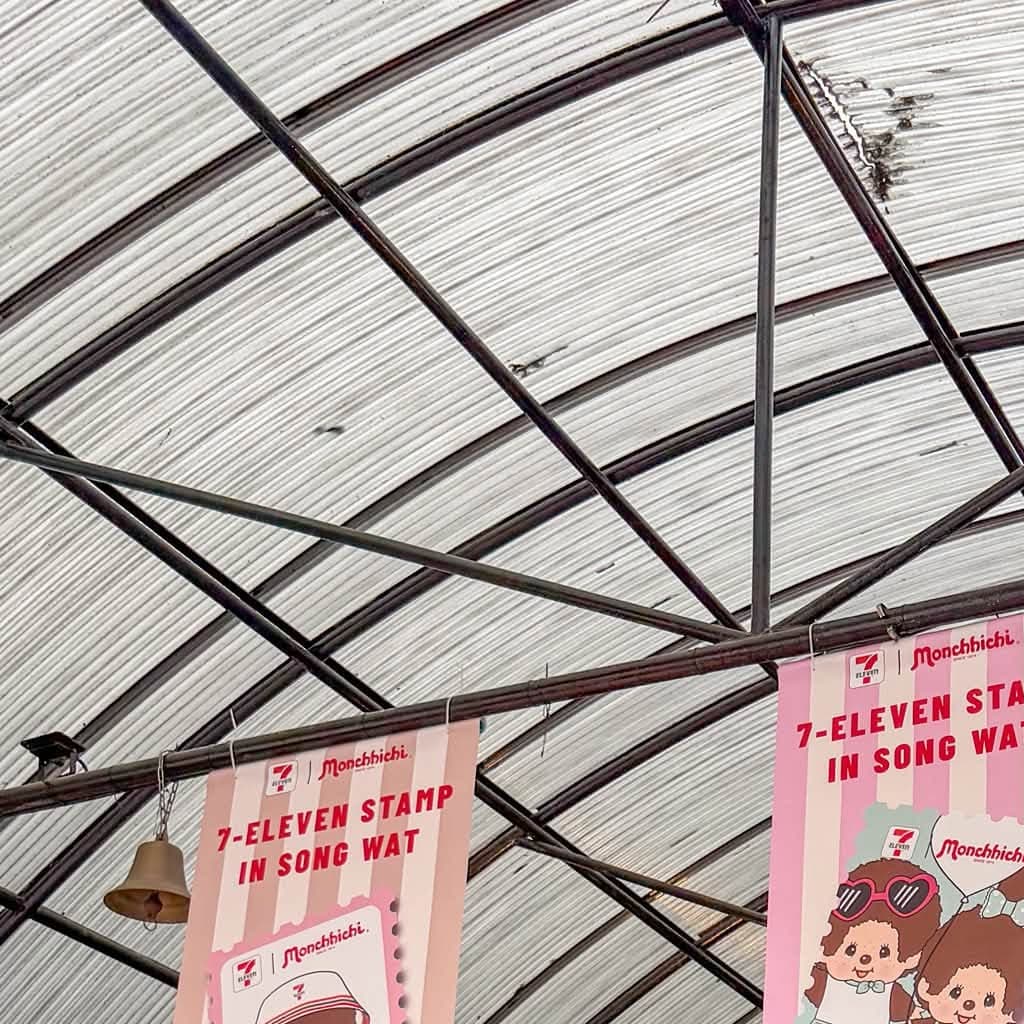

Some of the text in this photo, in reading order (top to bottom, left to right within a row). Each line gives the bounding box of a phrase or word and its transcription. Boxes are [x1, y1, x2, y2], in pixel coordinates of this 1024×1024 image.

[910, 631, 1014, 670] Monchhichi
[796, 693, 951, 749] 7-ELEVEN
[317, 745, 407, 781] Monchhichi
[828, 753, 859, 783] IN
[873, 734, 956, 773] SONG
[217, 785, 453, 853] 7-ELEVEN STAMP
[238, 828, 420, 885] IN SONG WAT
[282, 921, 365, 969] Monchhichi
